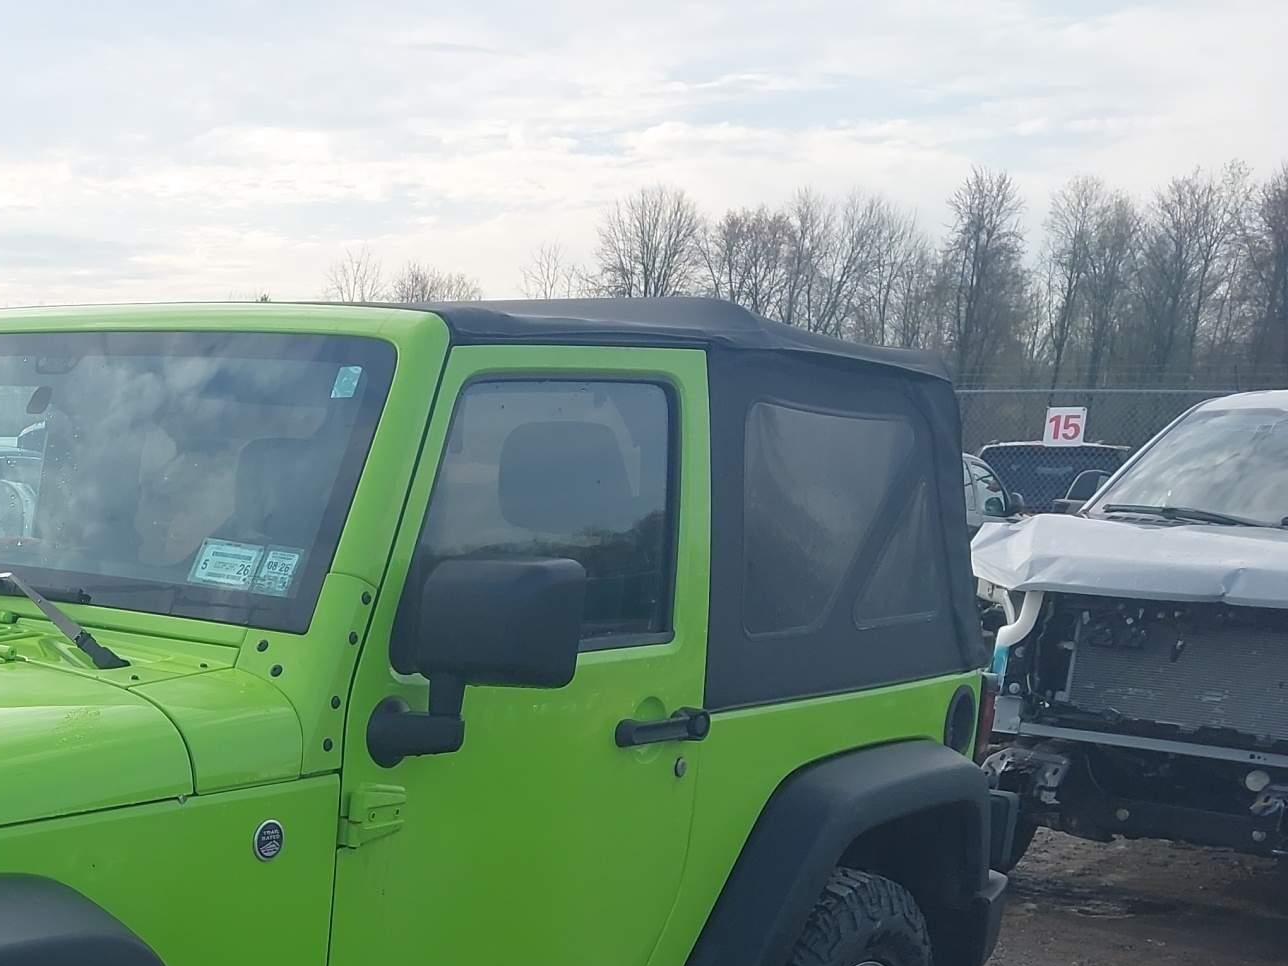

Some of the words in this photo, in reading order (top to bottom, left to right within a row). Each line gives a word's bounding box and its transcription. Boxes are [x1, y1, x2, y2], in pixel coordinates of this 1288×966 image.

[1049, 414, 1081, 440] 15
[201, 559, 209, 571] 5
[236, 563, 251, 577] 26
